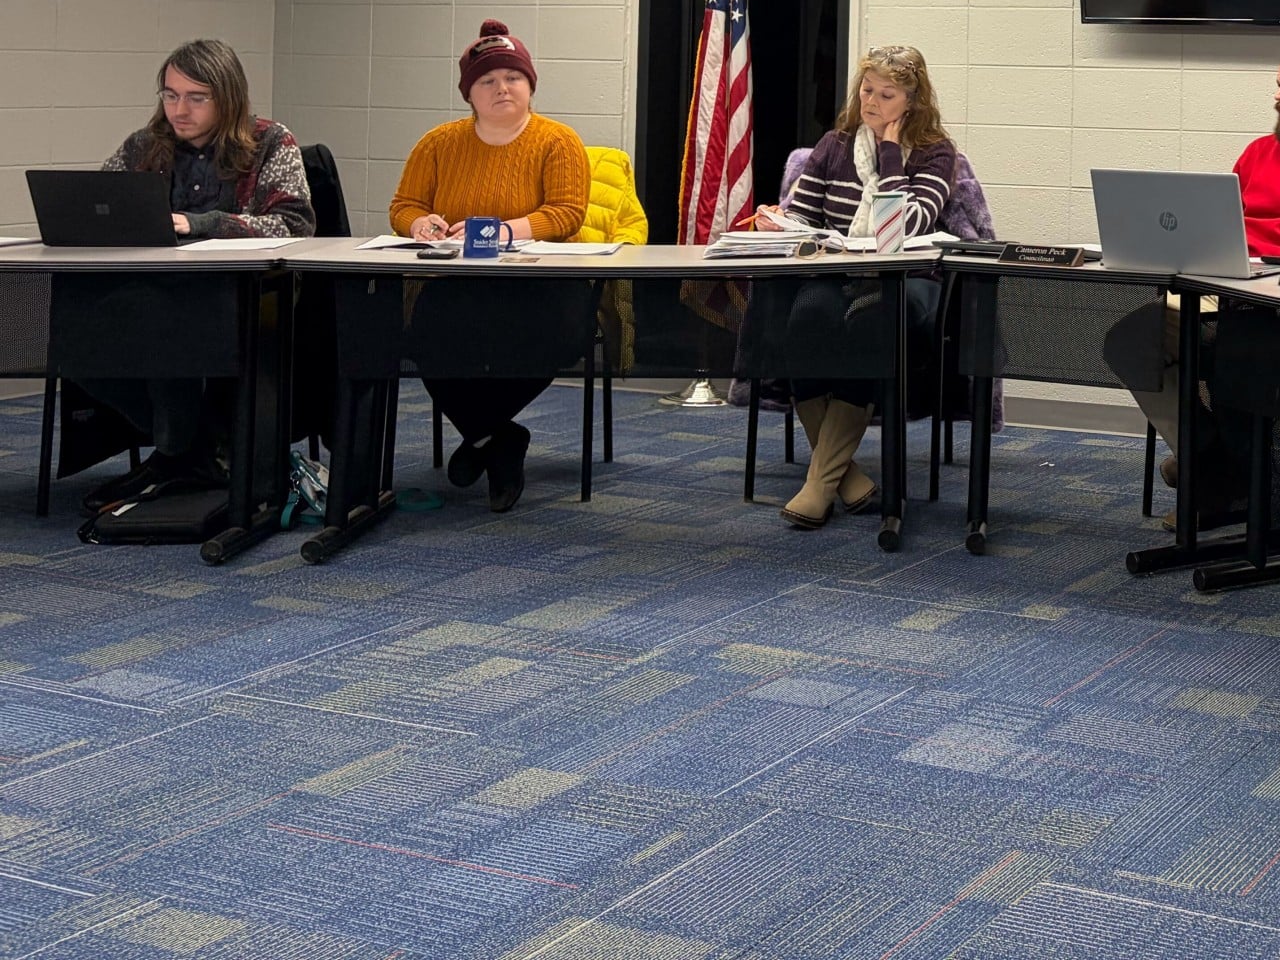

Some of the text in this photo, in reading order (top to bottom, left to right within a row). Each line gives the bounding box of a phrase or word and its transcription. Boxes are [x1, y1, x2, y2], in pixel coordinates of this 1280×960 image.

[1160, 210, 1178, 231] hp
[1015, 245, 1067, 256] Cameron Peck
[1018, 254, 1055, 262] Councilman
